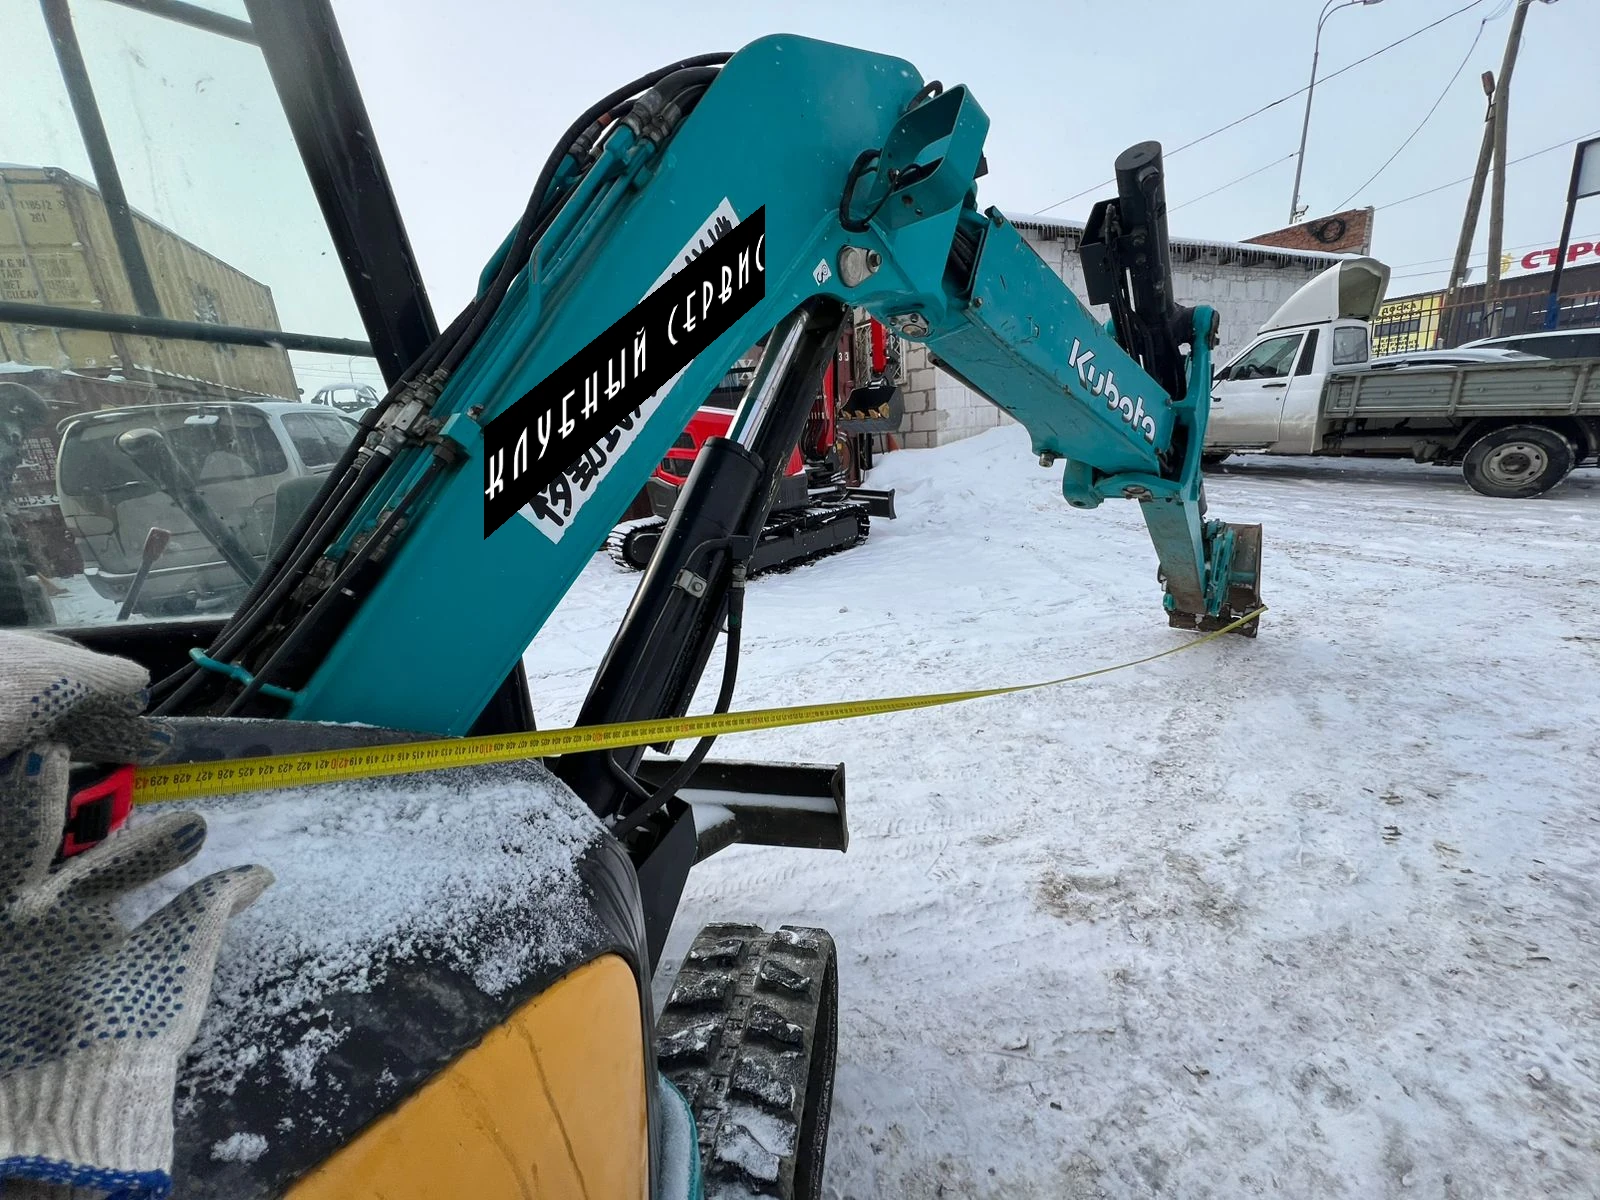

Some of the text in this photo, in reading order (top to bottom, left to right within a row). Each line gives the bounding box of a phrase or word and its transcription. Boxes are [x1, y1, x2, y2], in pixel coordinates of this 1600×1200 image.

[1381, 303, 1417, 316] ДОСКА
[1068, 338, 1156, 444] Kubota
[297, 762, 311, 771] 422
[316, 760, 329, 769] 421
[350, 757, 363, 766] 419
[238, 767, 254, 777] 425
[259, 766, 274, 775] 424
[278, 763, 293, 773] 423
[150, 776, 169, 786] 429
[174, 774, 191, 784] 428
[196, 772, 213, 782] 427
